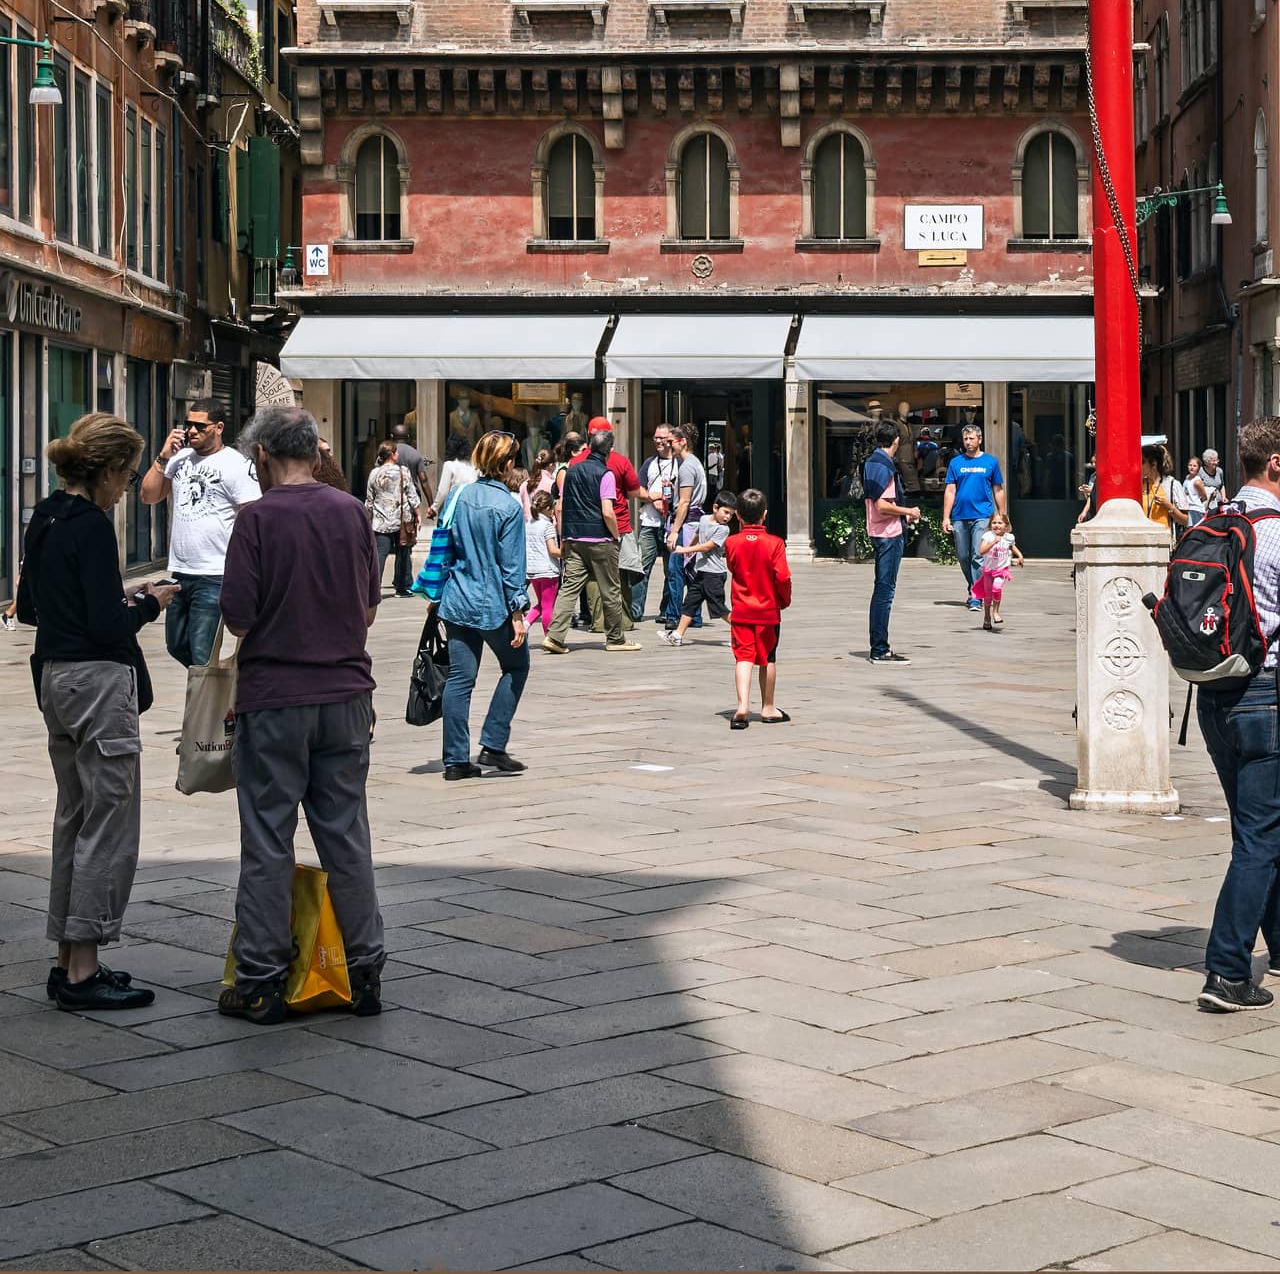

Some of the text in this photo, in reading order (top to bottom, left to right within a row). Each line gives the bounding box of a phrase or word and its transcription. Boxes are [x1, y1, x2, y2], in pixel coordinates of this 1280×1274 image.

[919, 213, 968, 224] CAMPO
[932, 231, 967, 241] LUCA
[310, 258, 325, 268] WC
[20, 280, 59, 330] UniCredit
